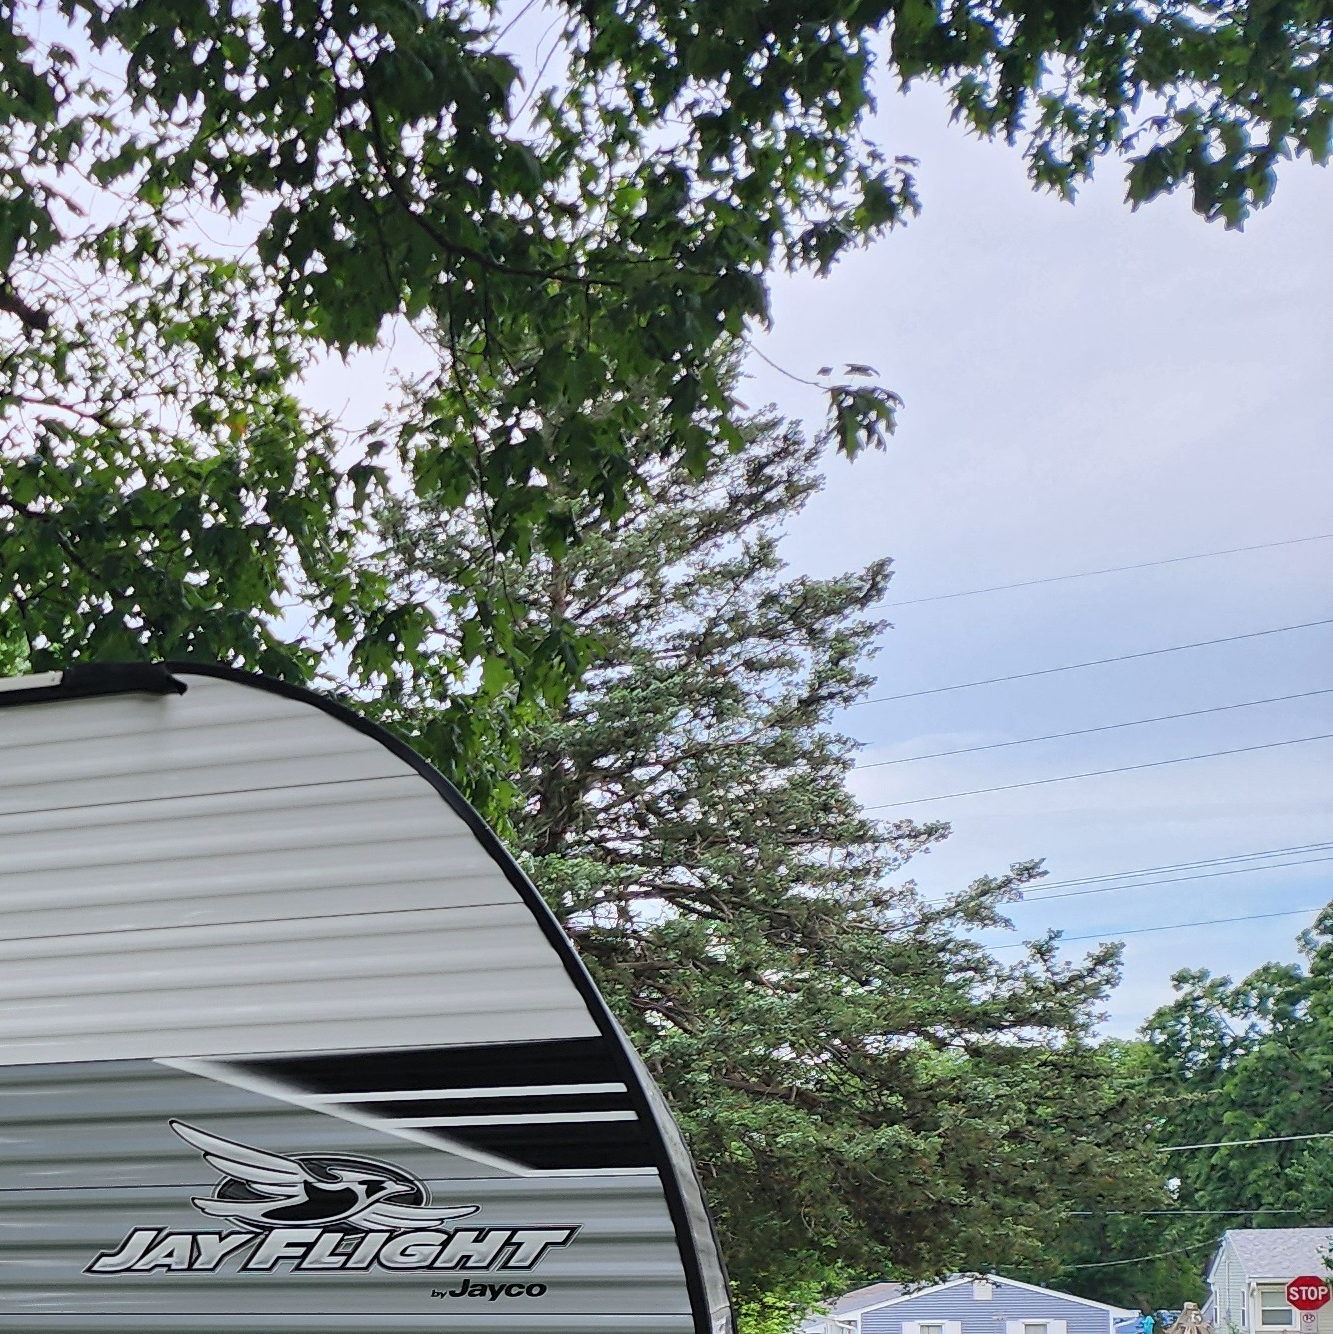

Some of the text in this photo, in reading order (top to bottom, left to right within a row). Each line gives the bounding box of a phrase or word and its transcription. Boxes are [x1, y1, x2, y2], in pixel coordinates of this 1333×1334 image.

[83, 1224, 582, 1273] JAY FLIGHT
[431, 1279, 547, 1301] by Jayco
[1289, 1286, 1328, 1300] STOP
